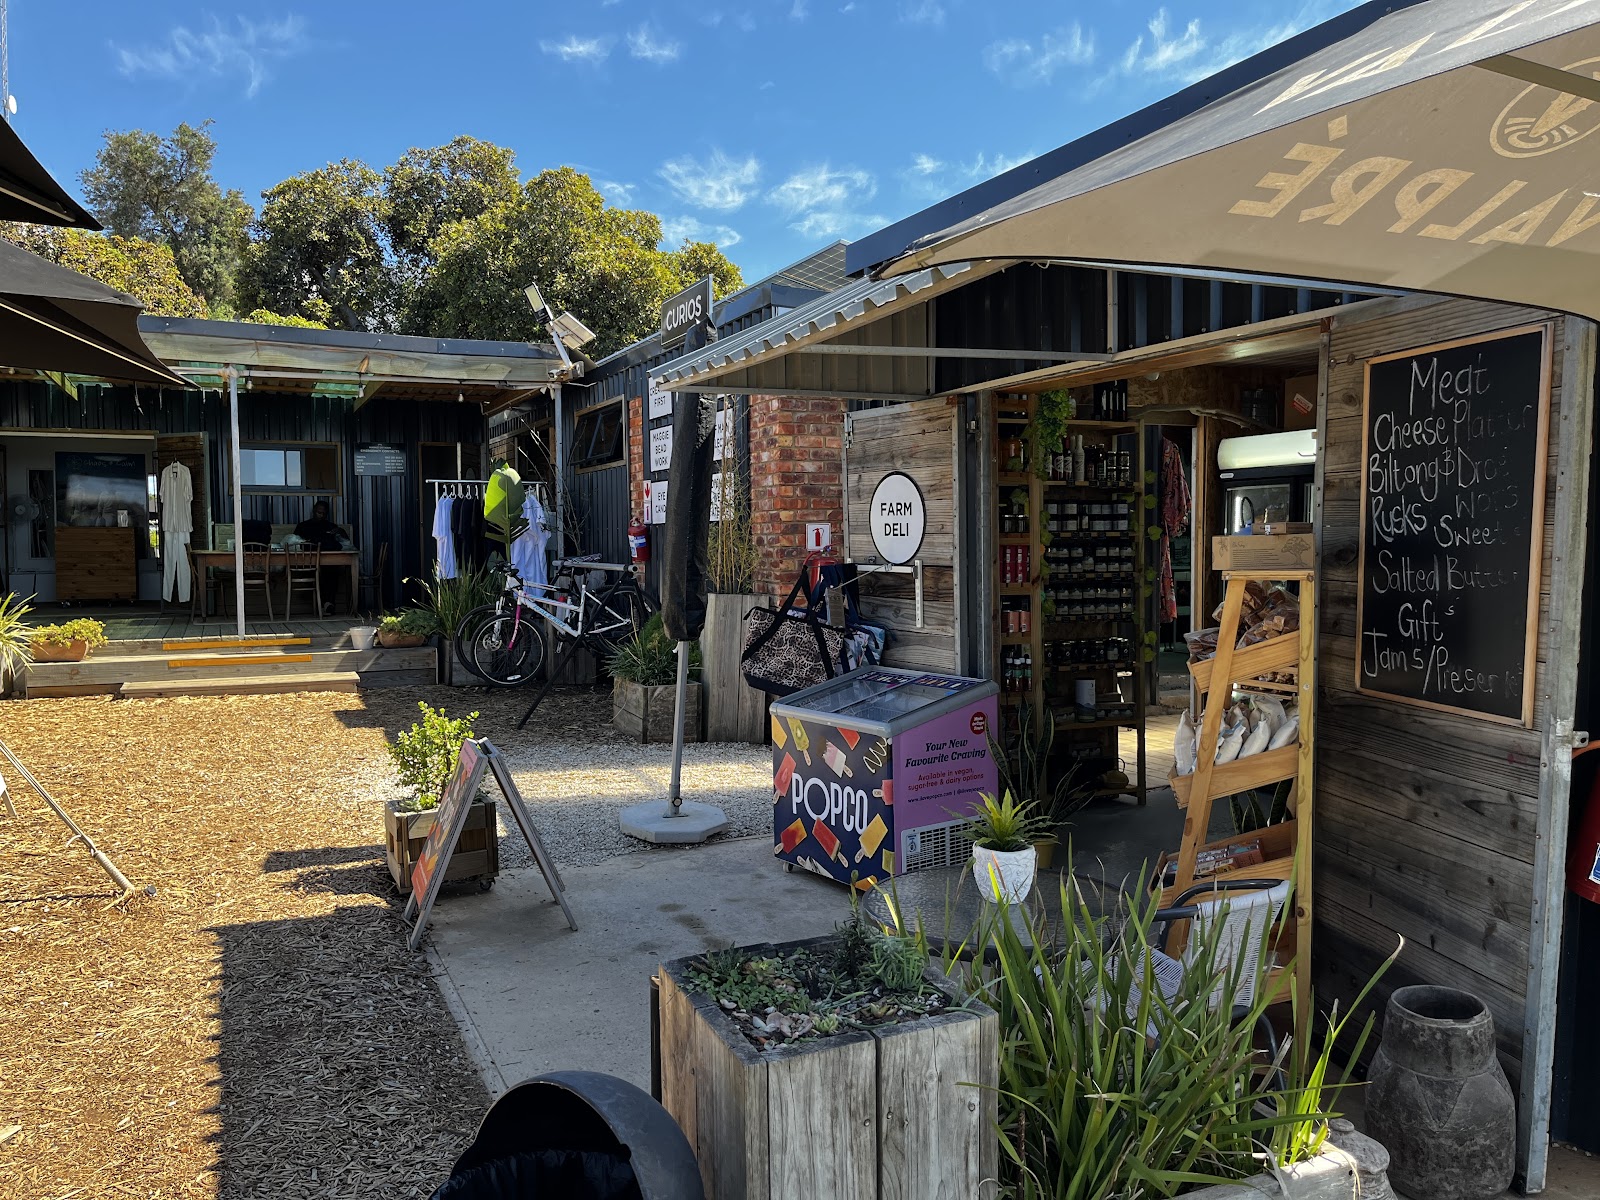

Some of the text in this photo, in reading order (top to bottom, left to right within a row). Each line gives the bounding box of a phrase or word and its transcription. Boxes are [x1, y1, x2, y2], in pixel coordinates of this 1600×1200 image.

[666, 294, 702, 331] CURIOS
[1408, 352, 1491, 416] Meat
[654, 395, 666, 407] FIRST
[1373, 399, 1533, 452] Cheese Plater
[652, 430, 669, 442] MAGGIE
[654, 456, 669, 467] WORK
[1369, 452, 1439, 502] Biltong
[657, 491, 666, 501] EYE
[655, 504, 667, 514] CAND
[880, 502, 912, 517] FARM
[1371, 494, 1427, 546] Rusks
[884, 522, 909, 537] DELI
[1372, 549, 1439, 594] Salted
[925, 739, 968, 752] Your New
[905, 748, 986, 768] Favourite Craving
[917, 771, 946, 781] Available
[962, 773, 984, 782] options
[791, 772, 868, 835] POPCO
